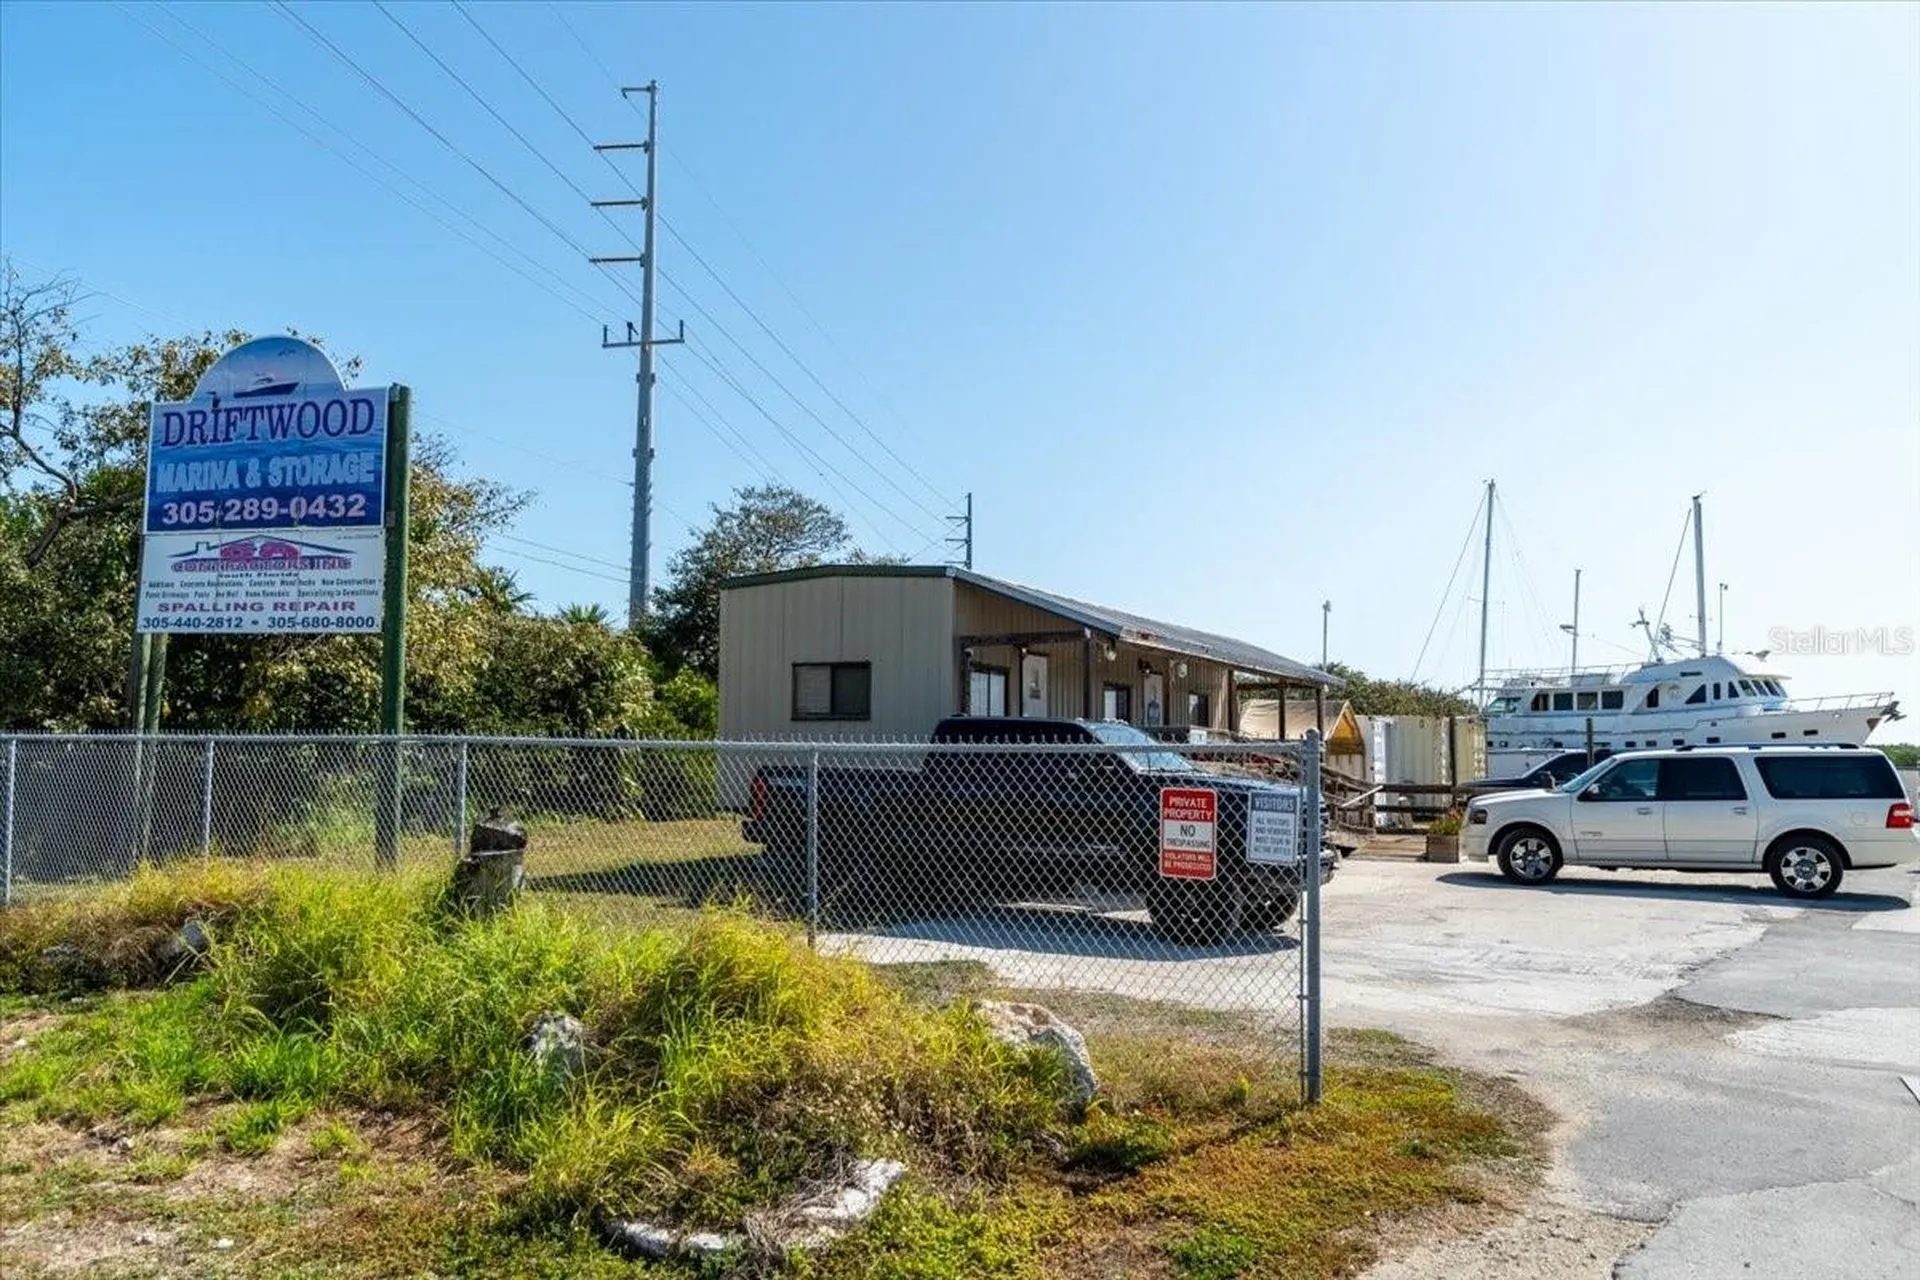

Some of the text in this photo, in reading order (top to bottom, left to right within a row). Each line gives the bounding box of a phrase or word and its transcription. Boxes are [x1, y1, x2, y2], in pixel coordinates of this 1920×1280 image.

[162, 398, 374, 447] DRIFTWOOD
[156, 453, 375, 492] MARINA & STORAGE
[157, 600, 356, 613] SPALLING REPAIR
[142, 615, 376, 629] 305-440-2812 305-680-8000
[1168, 796, 1208, 809] PRIVATE
[1255, 798, 1294, 811] VISITORS
[1163, 807, 1213, 820] PROPERTY
[1180, 824, 1196, 838] NO
